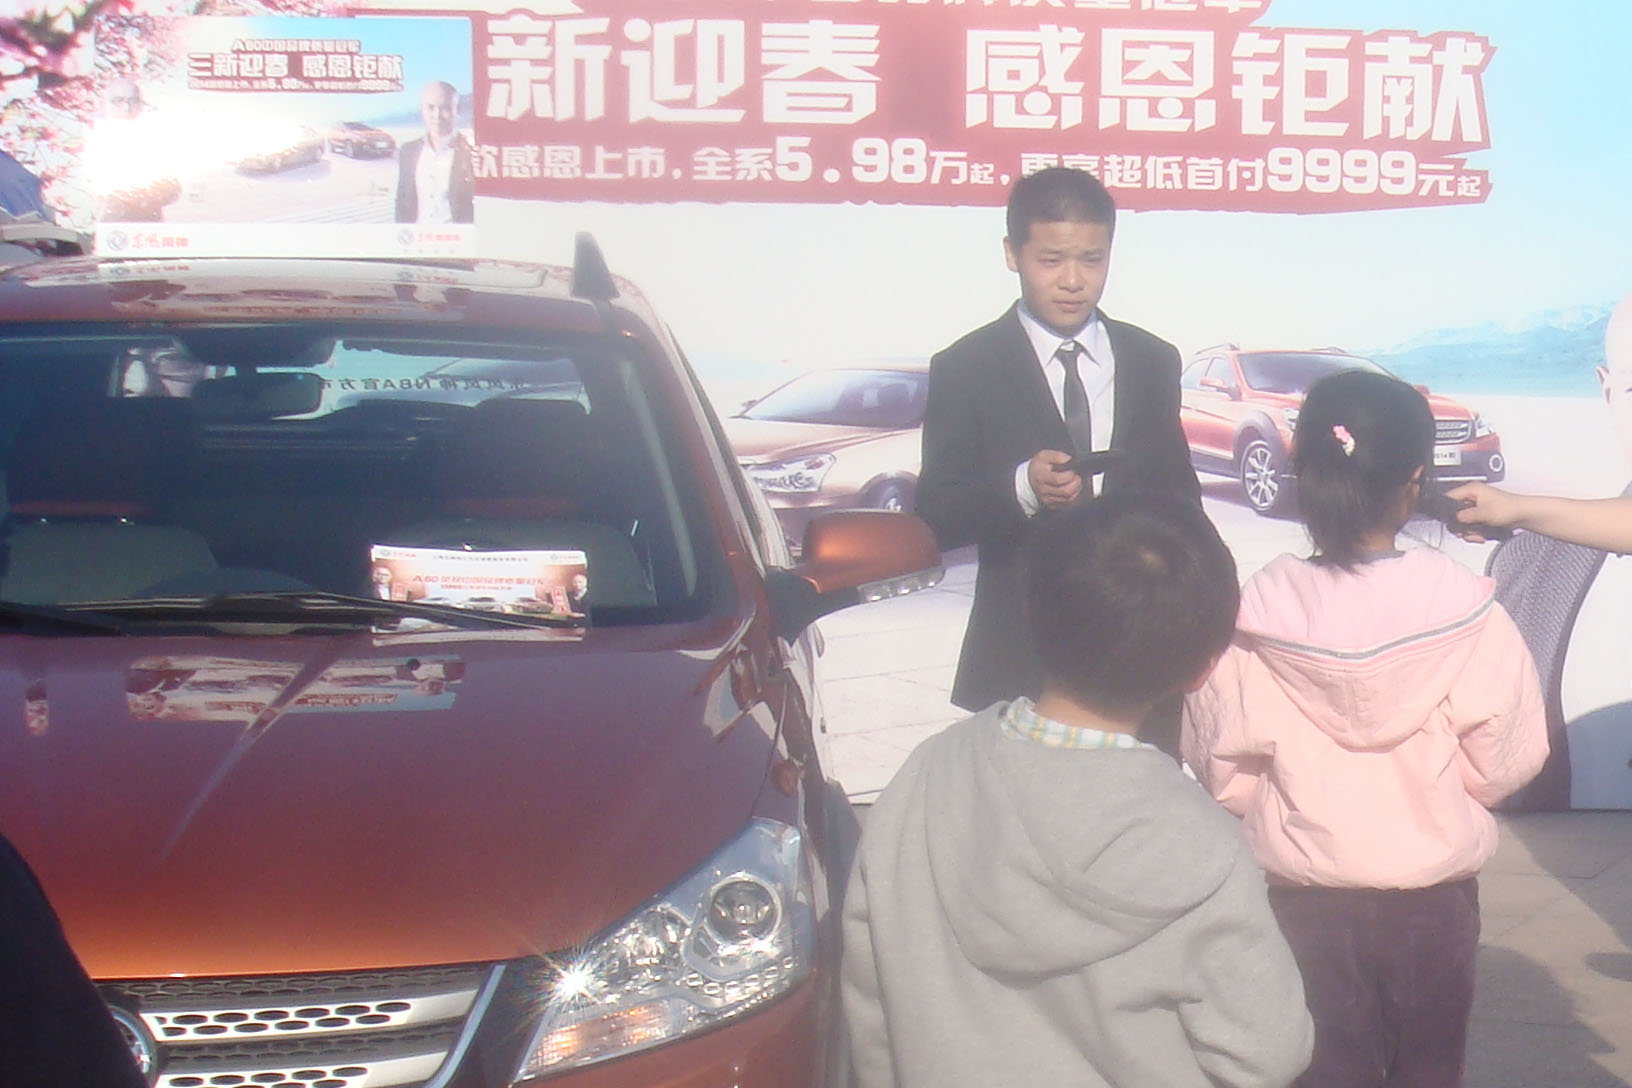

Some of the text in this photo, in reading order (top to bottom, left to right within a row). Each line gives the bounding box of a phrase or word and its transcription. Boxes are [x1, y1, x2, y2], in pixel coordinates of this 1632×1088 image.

[486, 15, 1486, 143] 新迎春 感恩钜献
